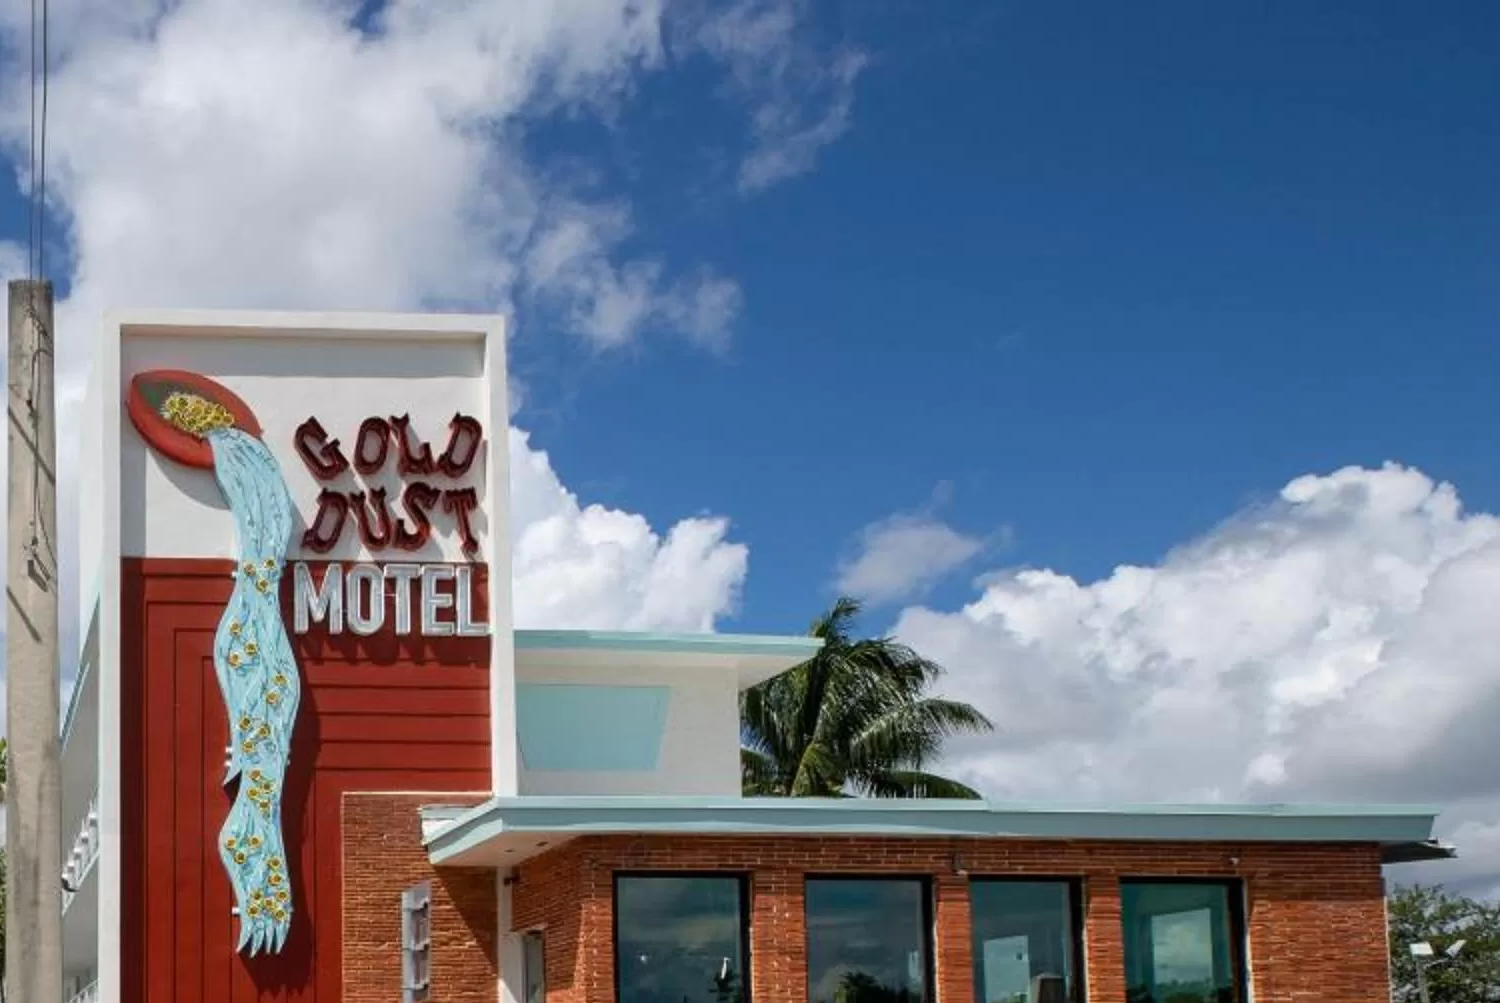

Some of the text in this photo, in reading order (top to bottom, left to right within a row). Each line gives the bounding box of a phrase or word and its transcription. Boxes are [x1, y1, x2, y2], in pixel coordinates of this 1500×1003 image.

[294, 413, 483, 480] GOLD
[301, 482, 480, 554] DUST
[294, 562, 491, 636] MOTEL
